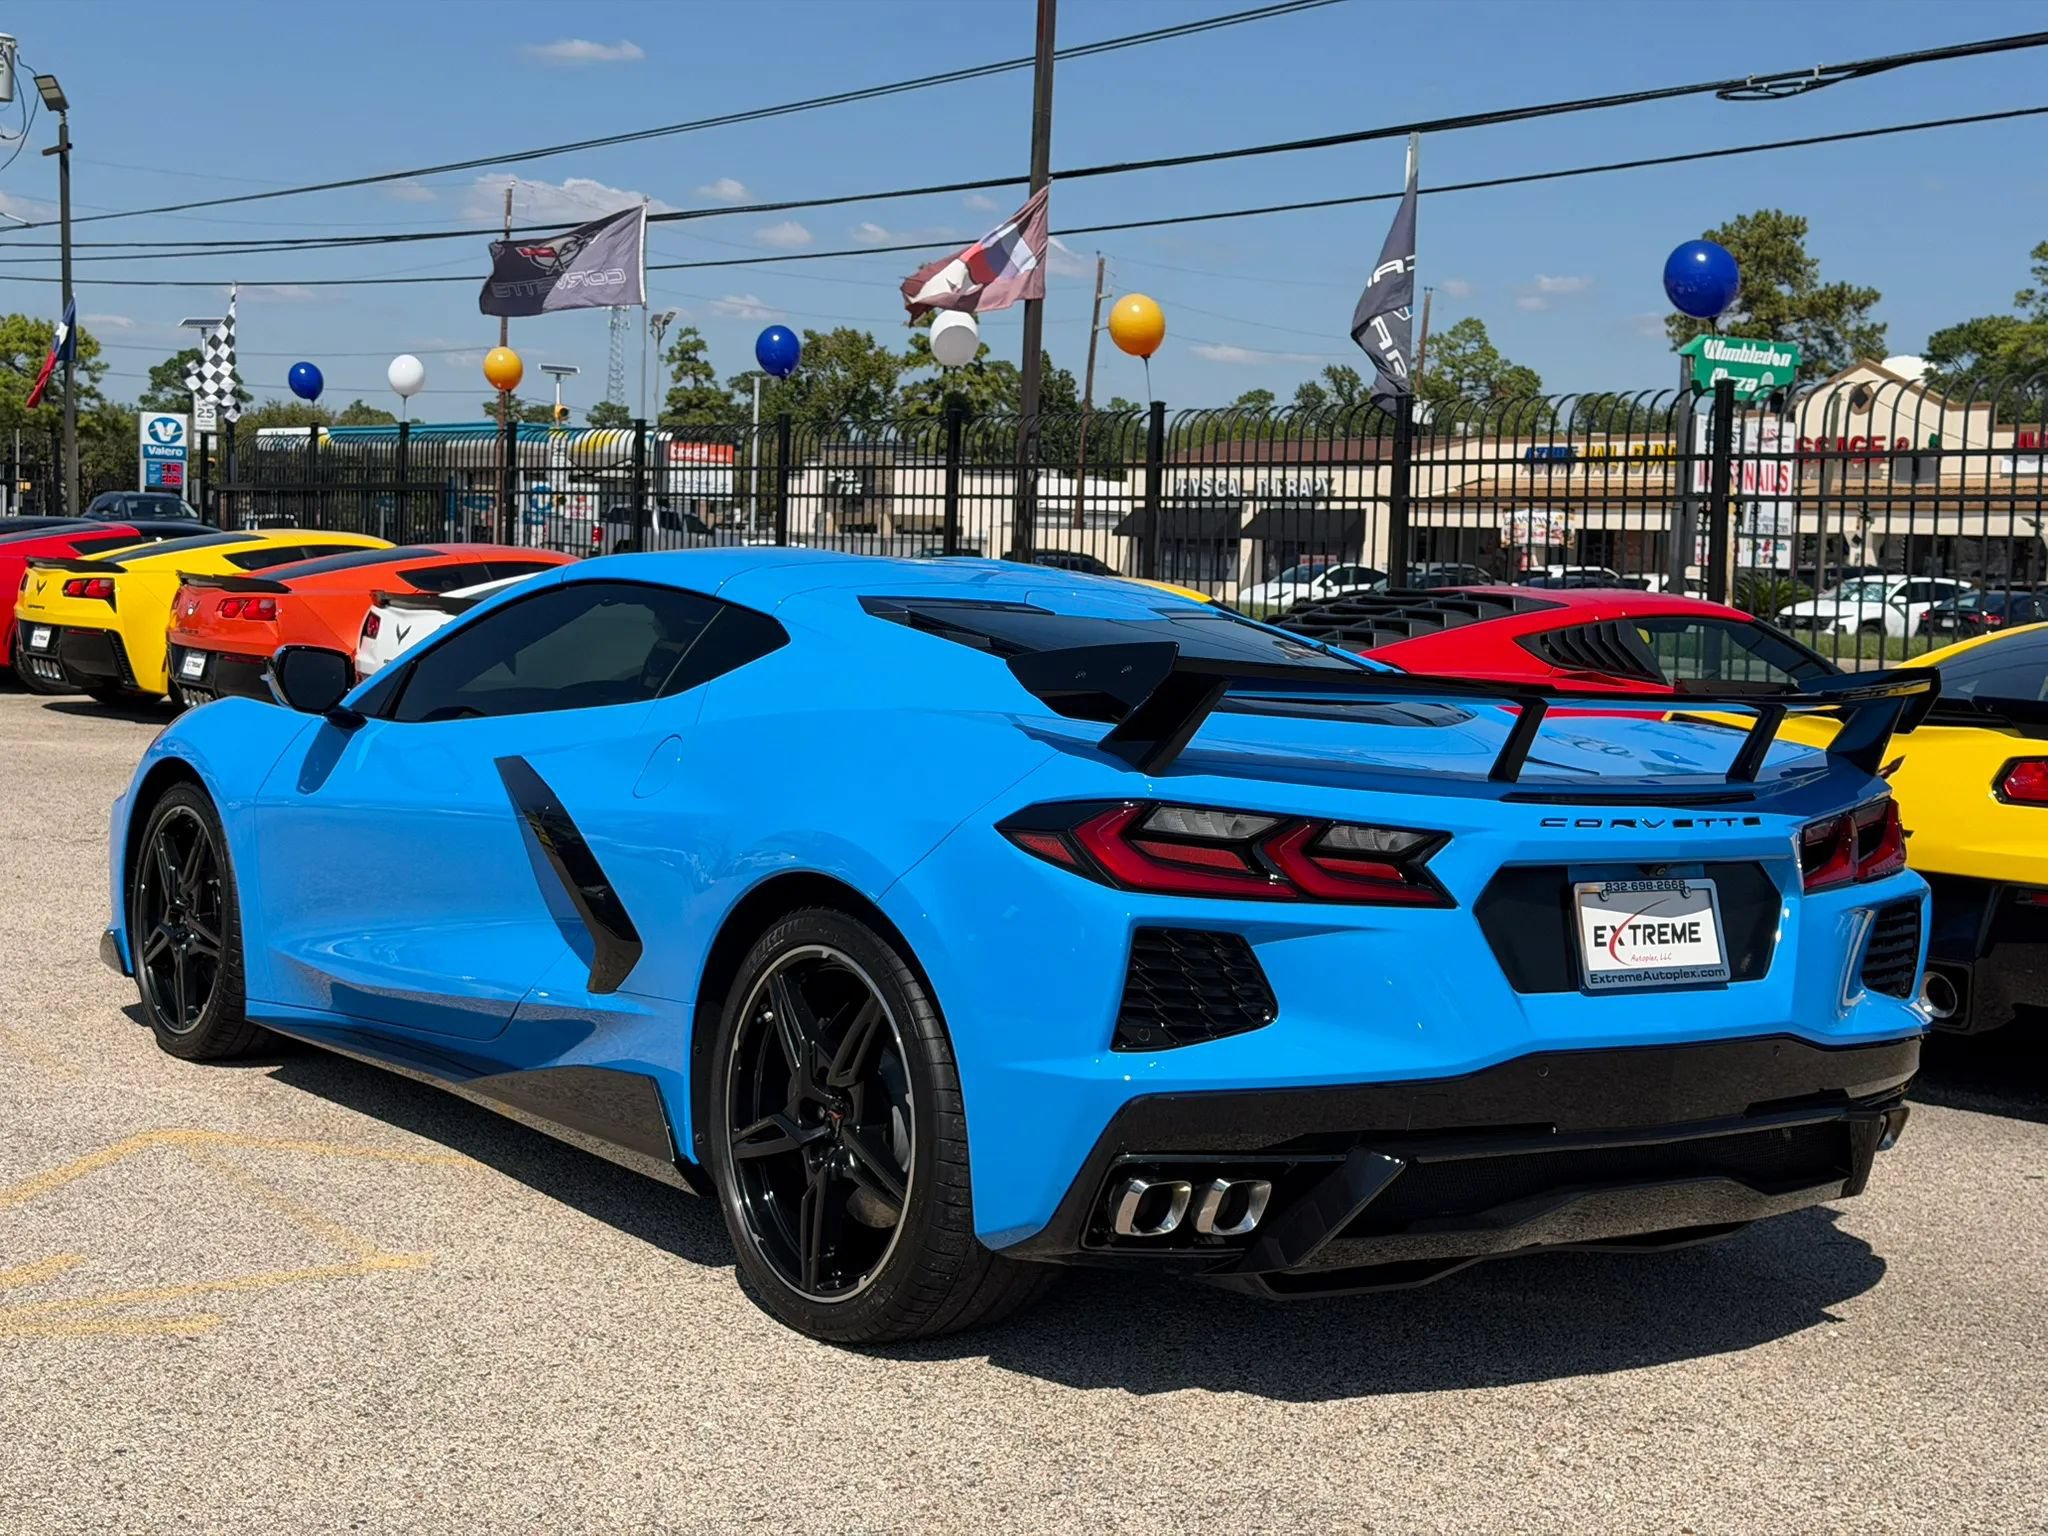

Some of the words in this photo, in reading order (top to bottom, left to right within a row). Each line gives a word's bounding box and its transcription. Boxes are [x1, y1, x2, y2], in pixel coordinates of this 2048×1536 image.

[1703, 338, 1793, 368] Wimbledon
[1710, 366, 1759, 392] Plza
[197, 407, 215, 420] 25
[147, 445, 184, 457] Valero
[1173, 477, 1249, 498] PHYSCA
[1744, 463, 1790, 494] NAILS
[1539, 816, 1763, 829] CORVETTE
[1592, 921, 1703, 948] EXTREME
[1590, 966, 1727, 986] ExtremeAutoplex.com
